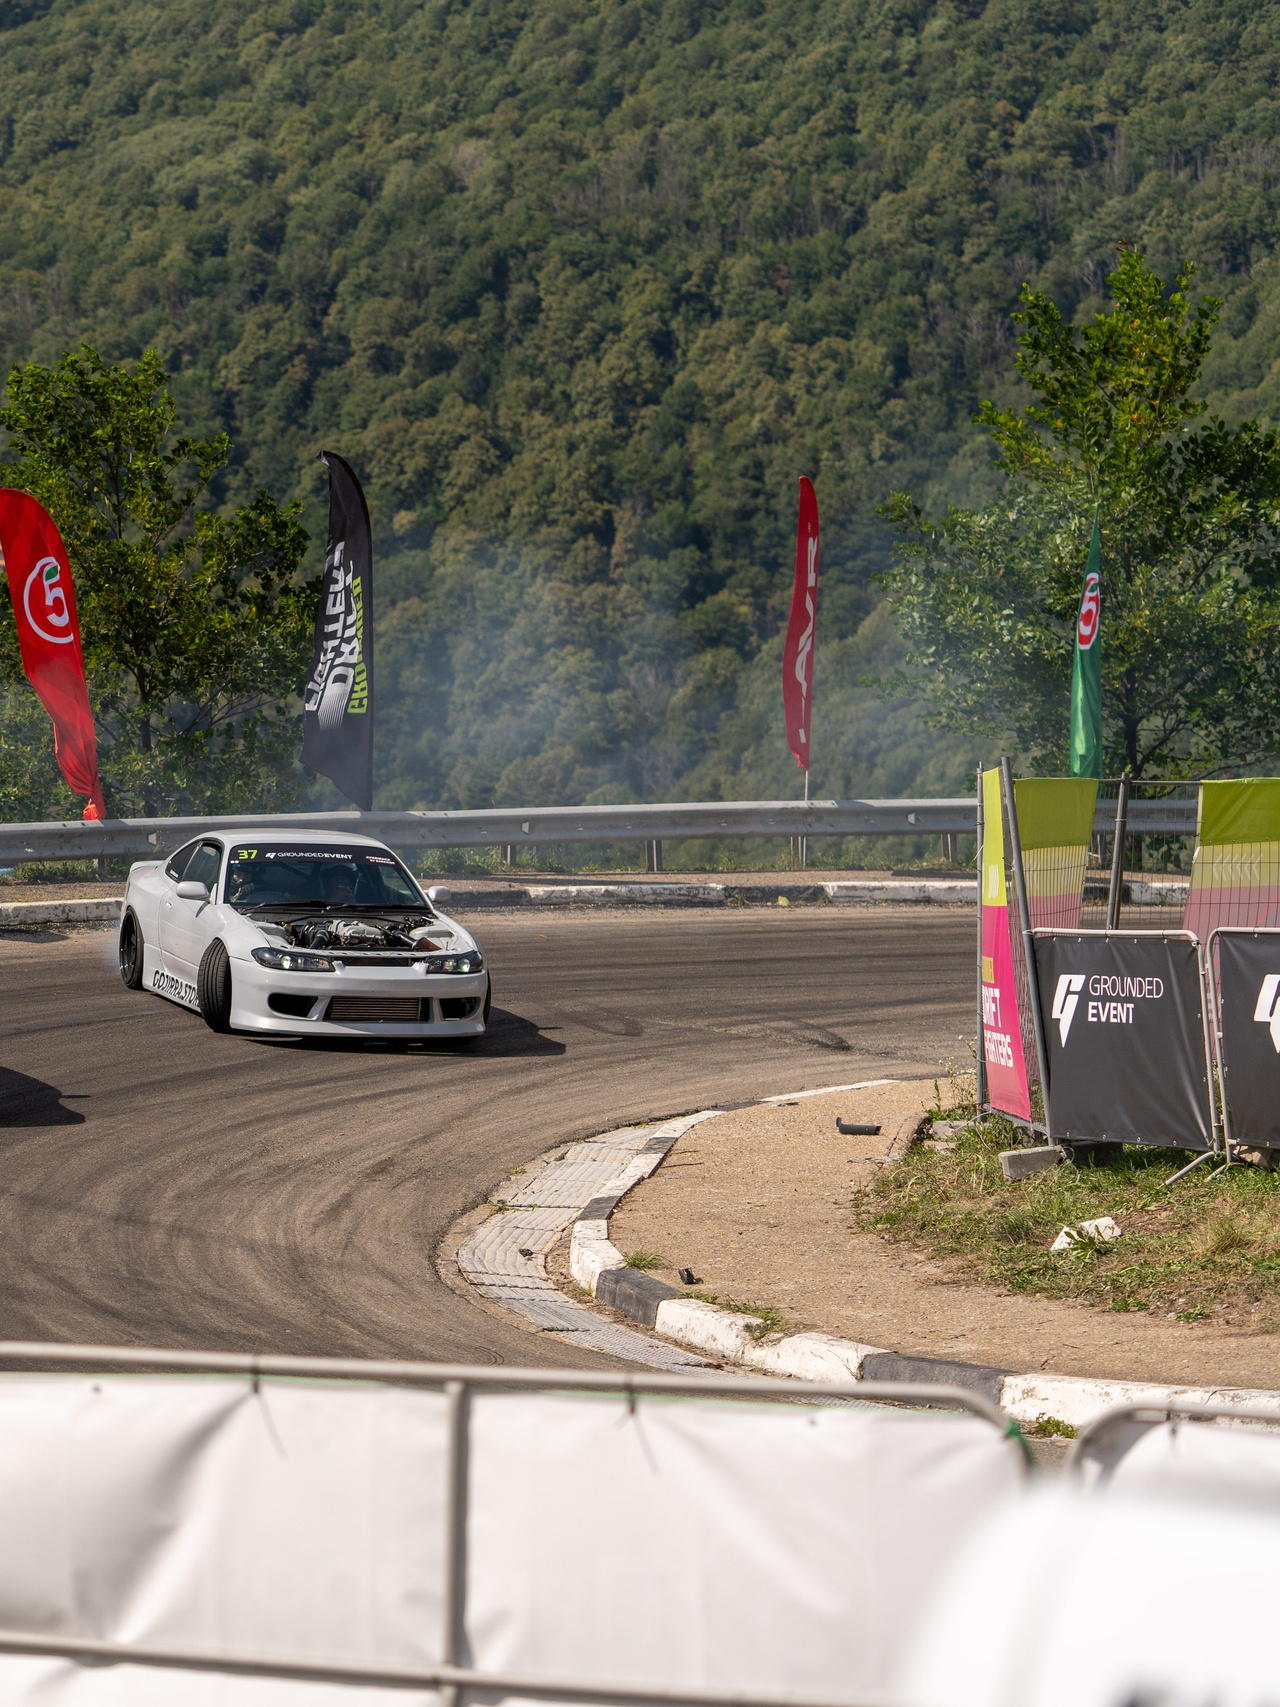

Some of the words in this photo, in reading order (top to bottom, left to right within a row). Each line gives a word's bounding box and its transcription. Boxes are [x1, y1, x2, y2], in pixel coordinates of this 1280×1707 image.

[237, 849, 258, 860] 37
[1089, 975, 1164, 998] GROUNDED
[1087, 1002, 1134, 1024] EVENT
